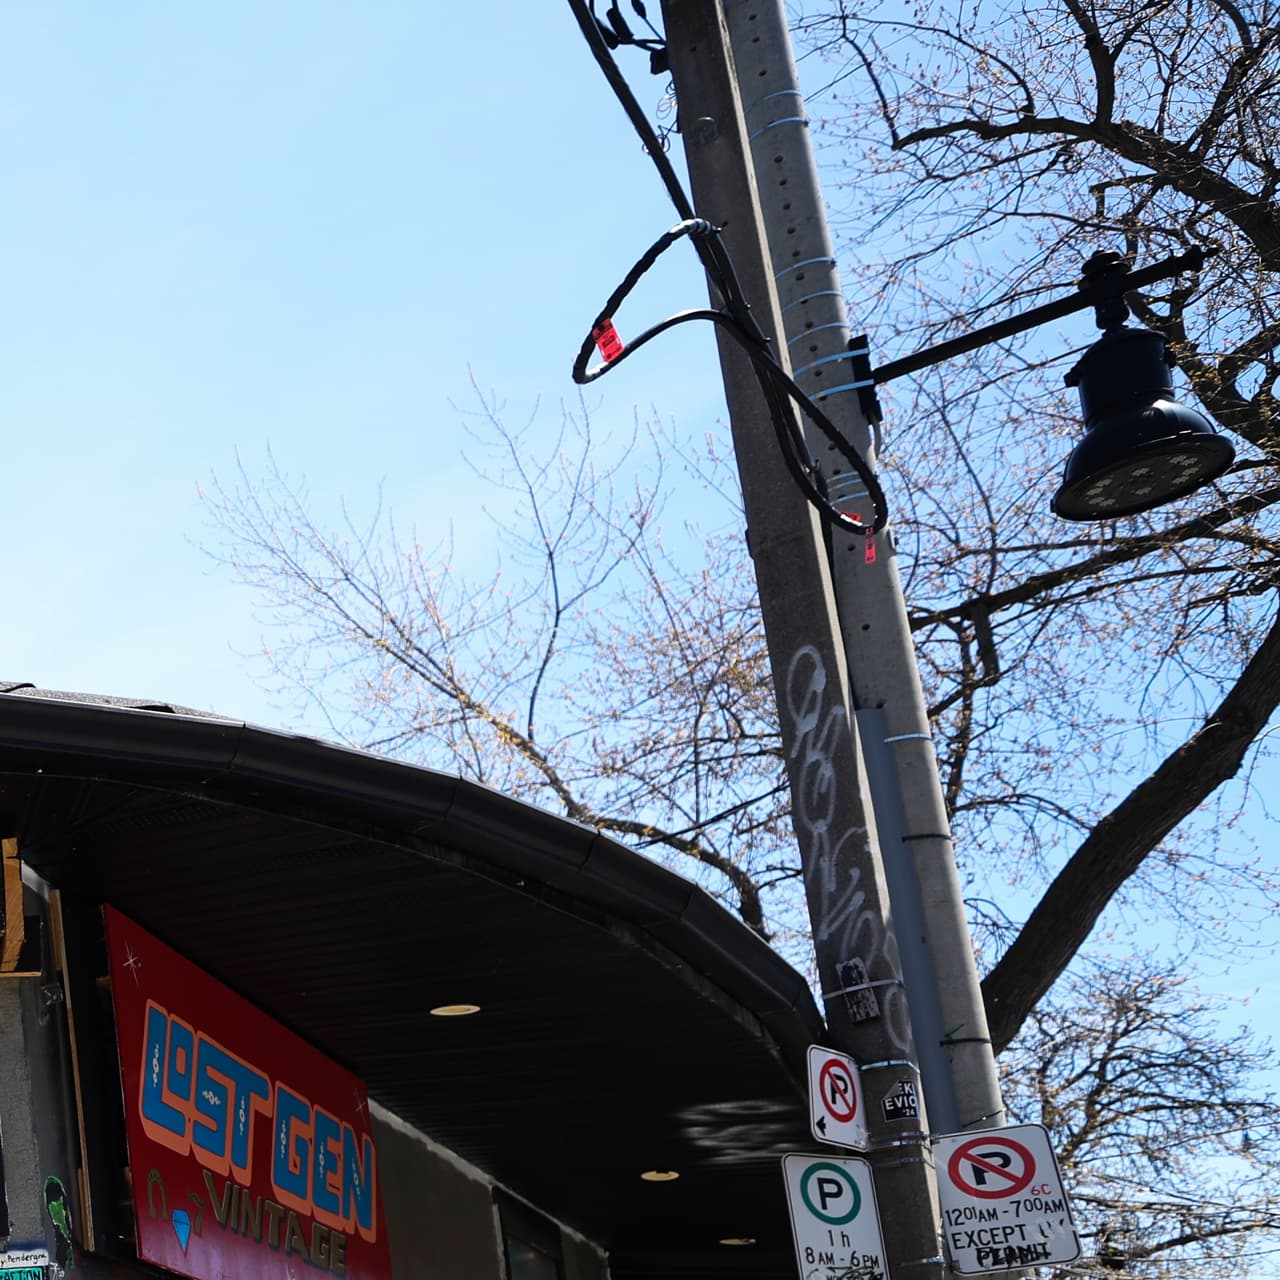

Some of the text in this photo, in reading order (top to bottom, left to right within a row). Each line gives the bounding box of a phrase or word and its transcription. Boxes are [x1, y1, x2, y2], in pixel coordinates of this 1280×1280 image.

[140, 999, 376, 1244] LOST GEN
[203, 1169, 348, 1277] VINTAGE
[952, 1224, 1027, 1249] EXCEPT
